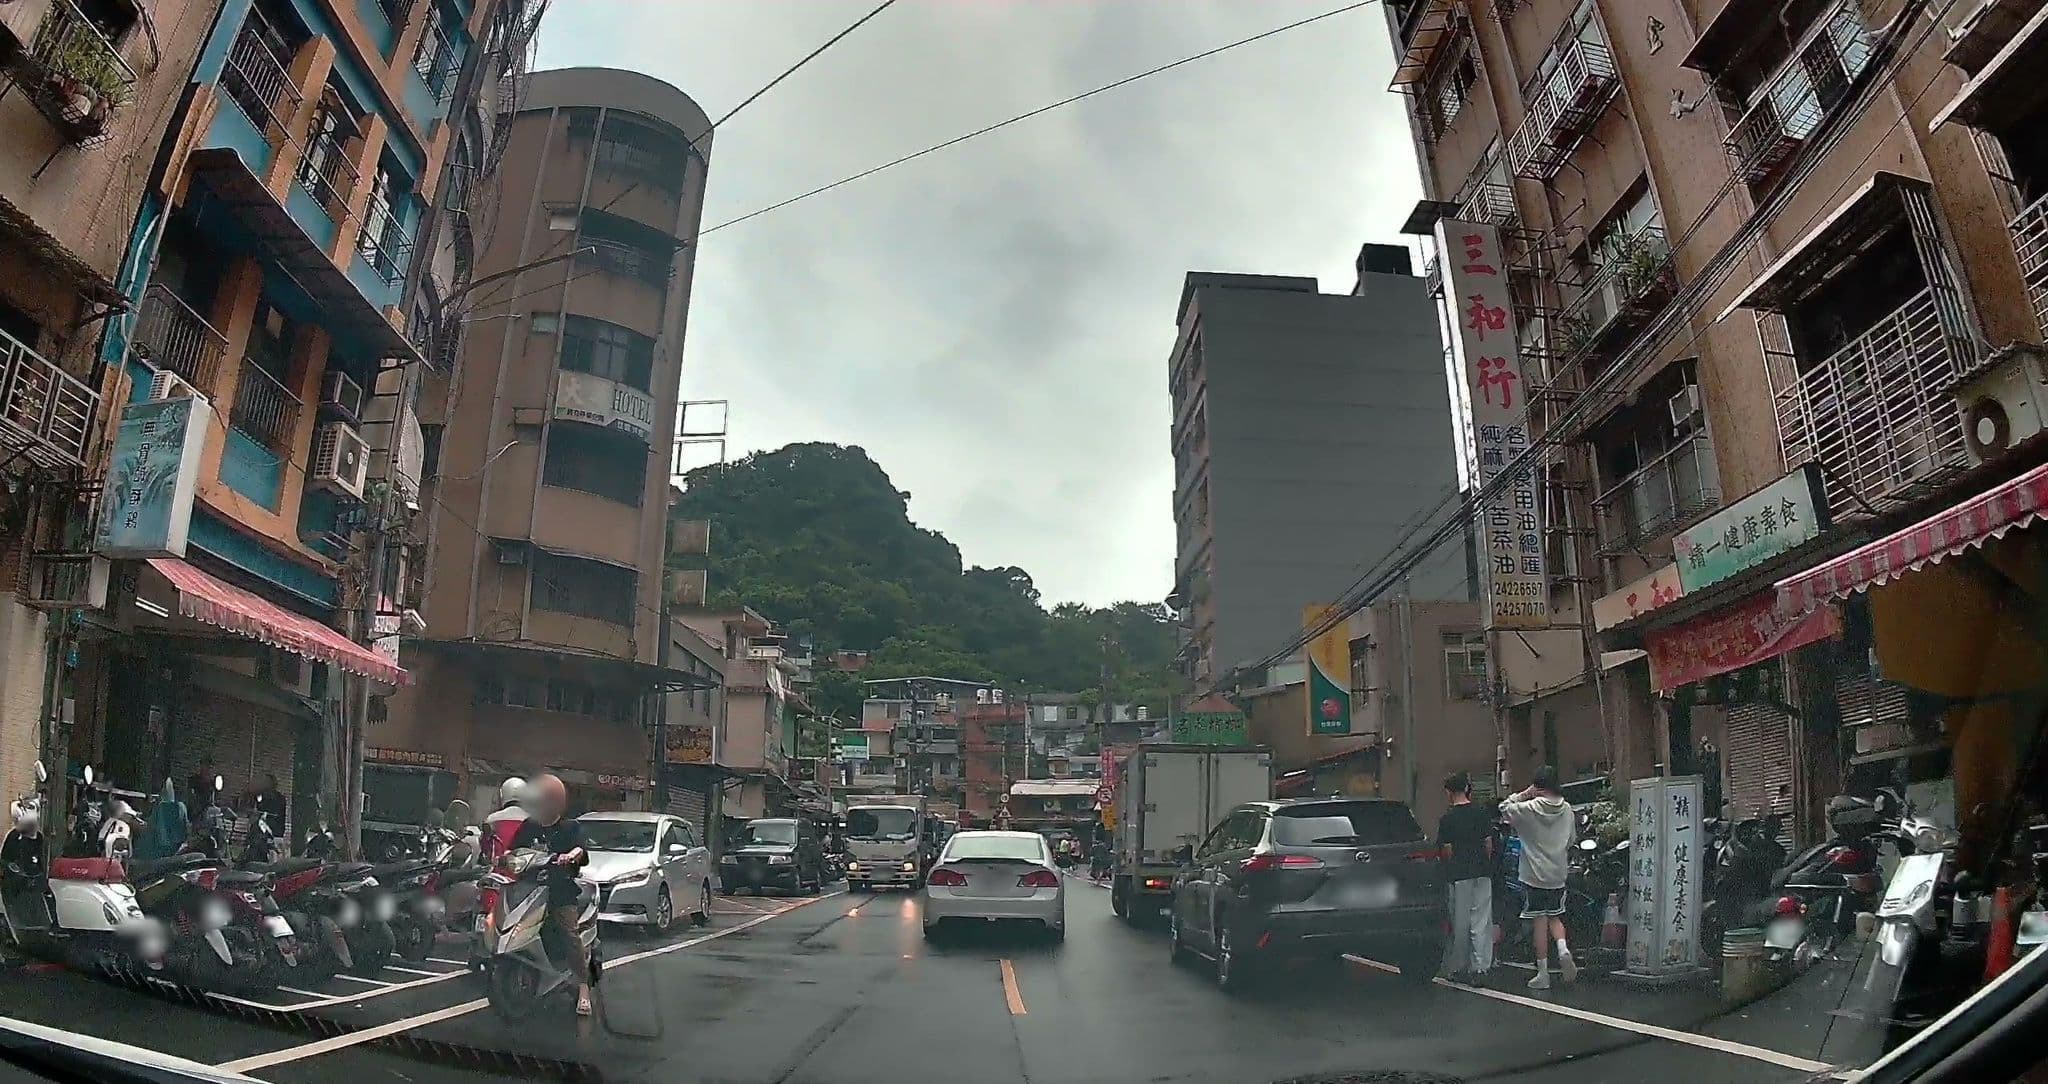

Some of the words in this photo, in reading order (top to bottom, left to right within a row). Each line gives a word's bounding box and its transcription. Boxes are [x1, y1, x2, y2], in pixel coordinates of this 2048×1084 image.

[1461, 234, 1517, 410] 三和行
[612, 388, 652, 425] HOTEL
[1489, 505, 1516, 575] 苦茶油
[1688, 496, 1800, 571] 精一健康素食
[1495, 602, 1545, 617] 24257070
[1671, 795, 1691, 933] 精一健康素食
